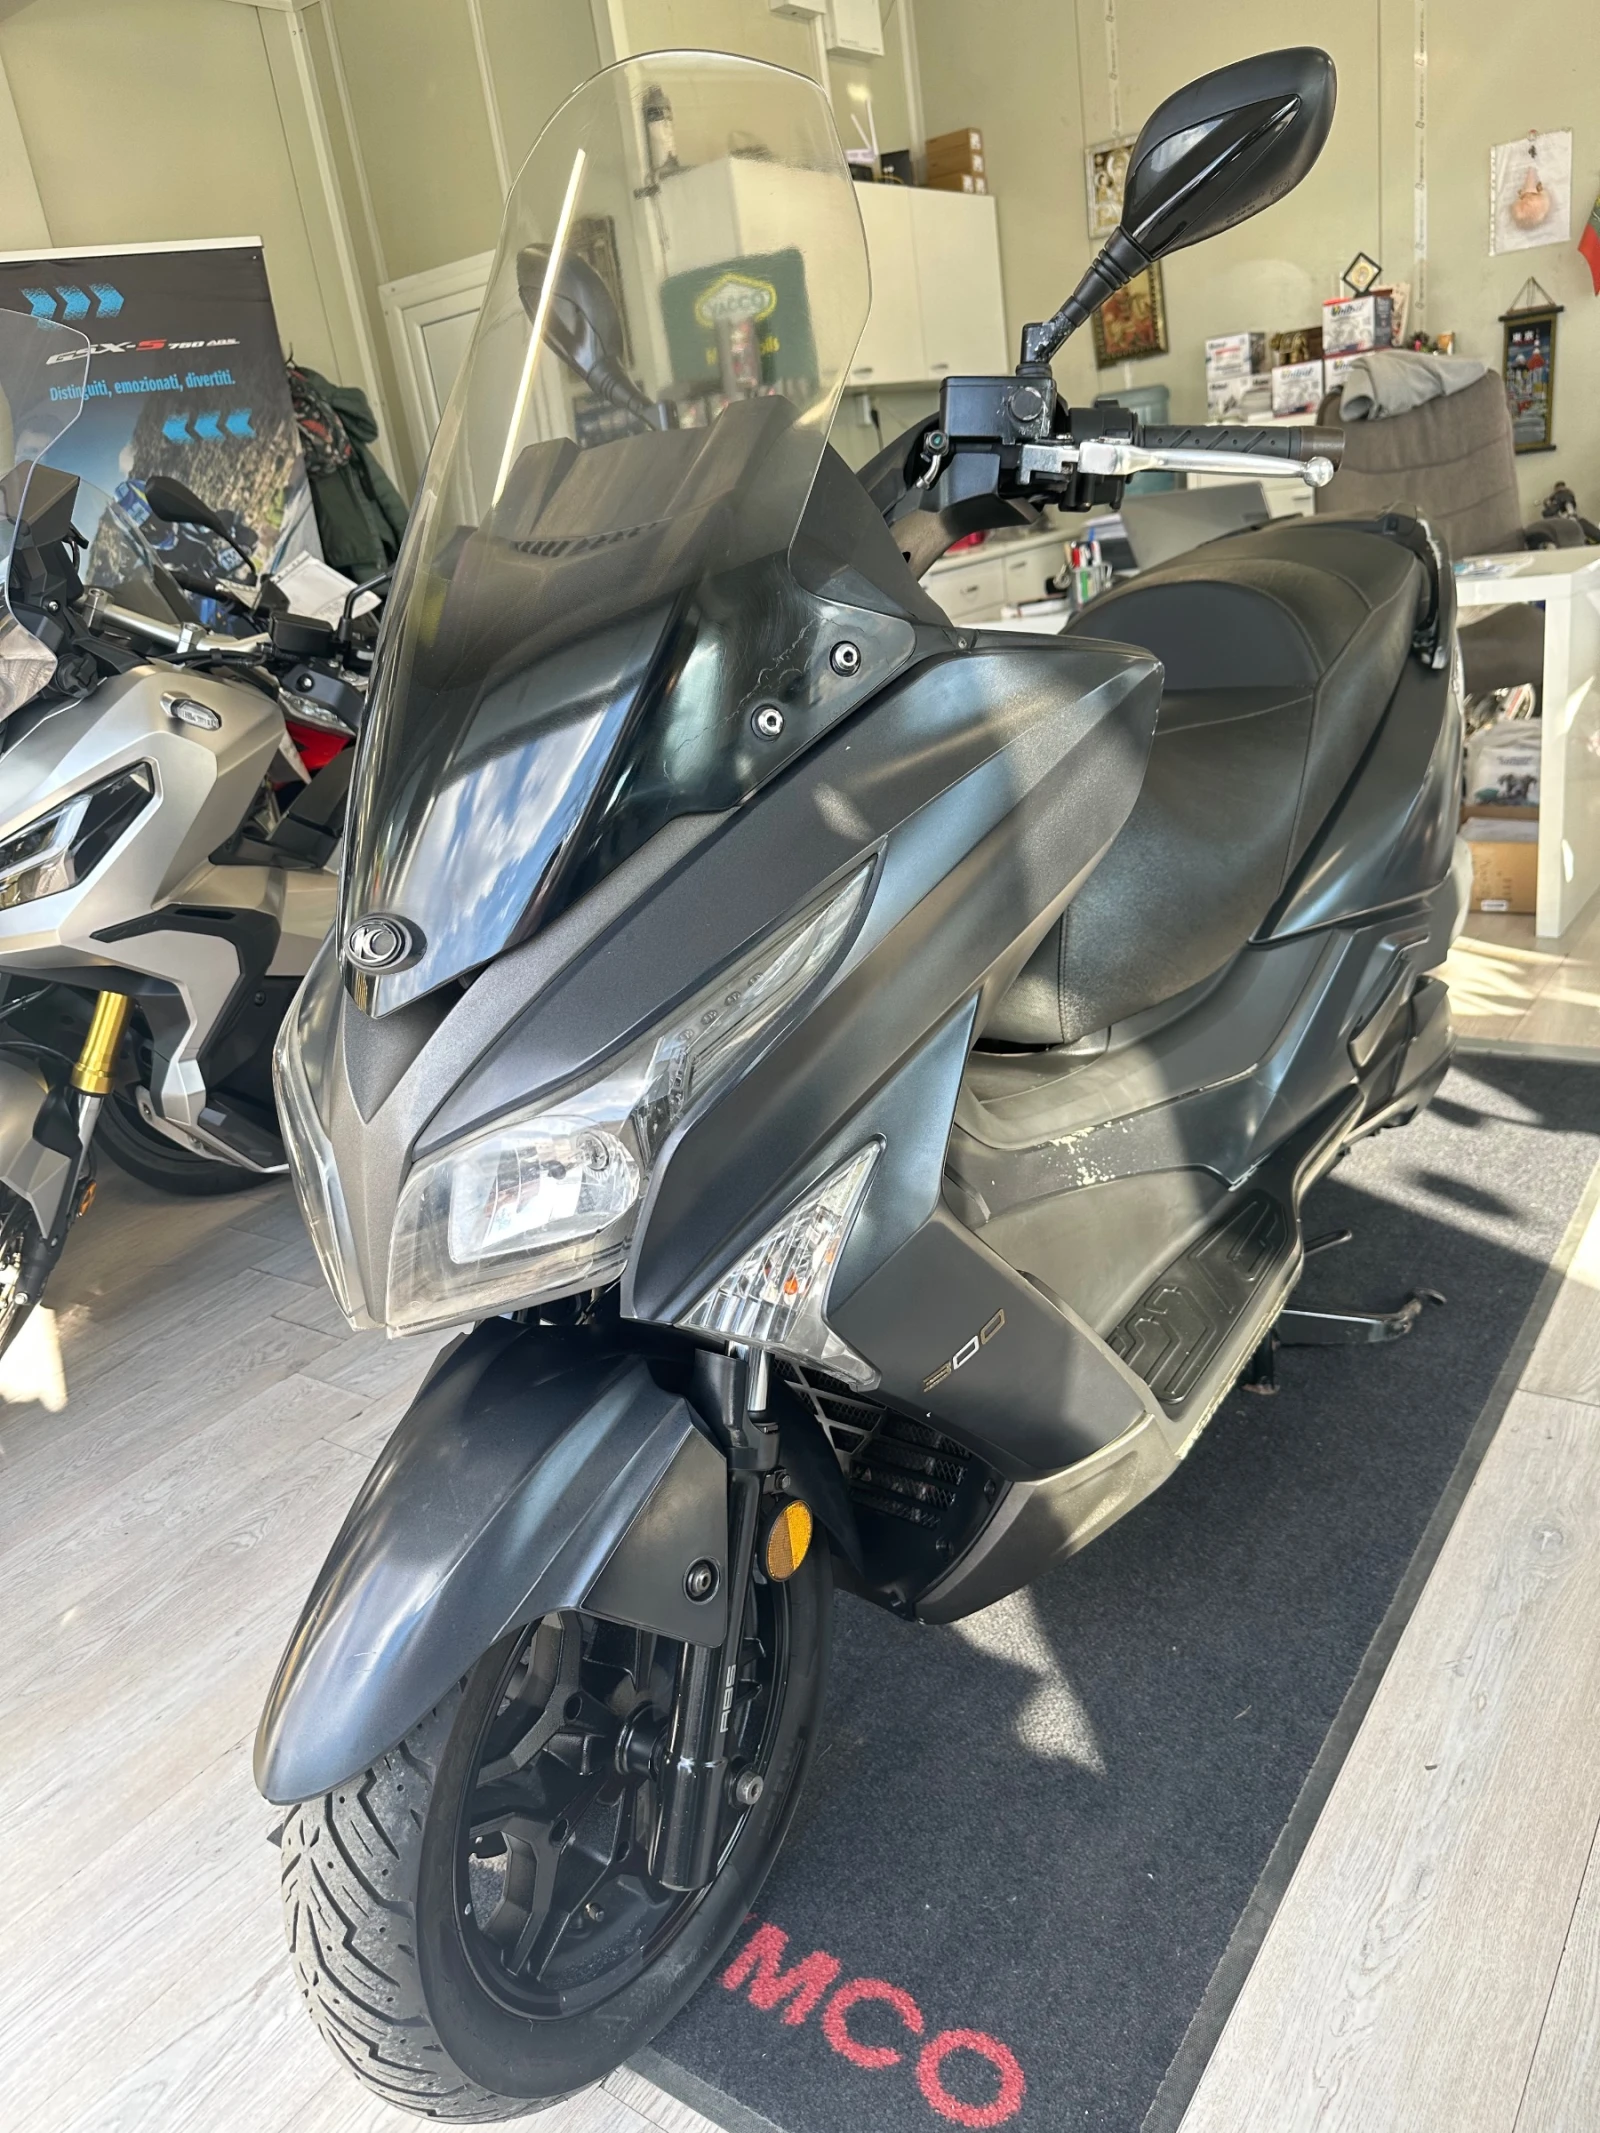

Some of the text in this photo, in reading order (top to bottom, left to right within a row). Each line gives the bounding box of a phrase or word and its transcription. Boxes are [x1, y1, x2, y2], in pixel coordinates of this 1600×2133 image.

[45, 338, 168, 365] GSX-S
[168, 340, 205, 350] 750
[49, 369, 236, 402] Distinguiti, emozionati, divertiti.
[922, 1308, 1006, 1393] 300
[719, 1664, 737, 1733] ABS
[718, 1912, 1027, 2128] MCO
